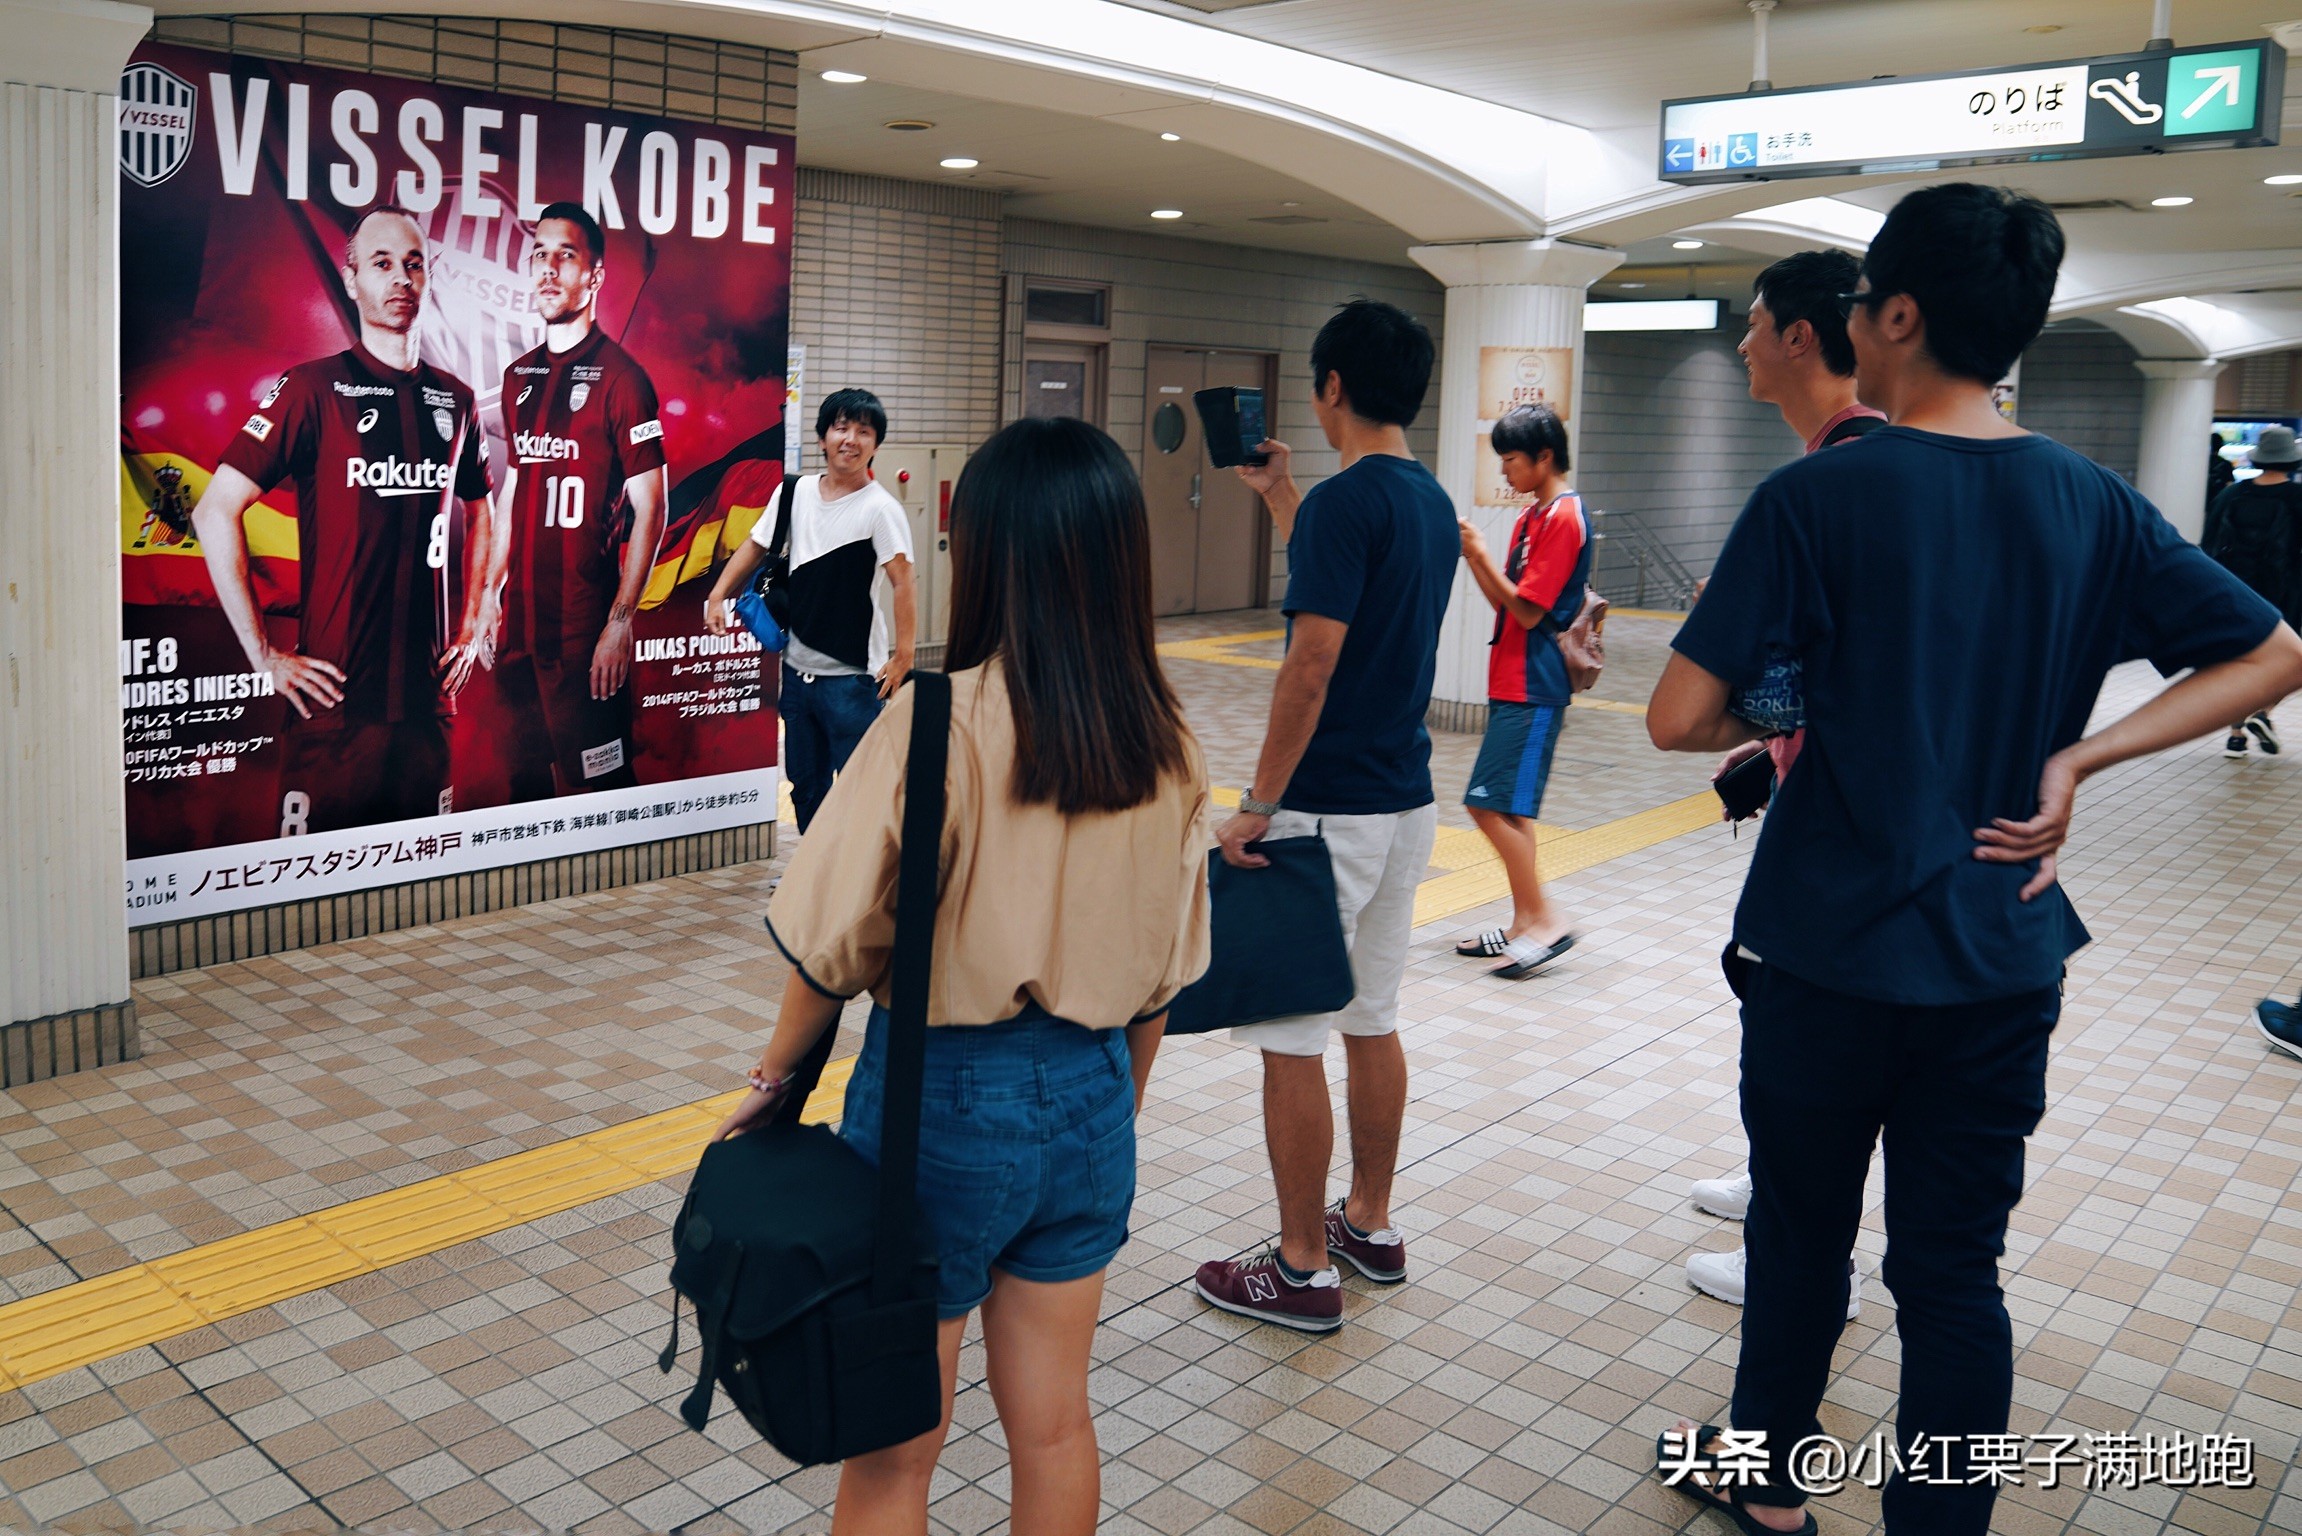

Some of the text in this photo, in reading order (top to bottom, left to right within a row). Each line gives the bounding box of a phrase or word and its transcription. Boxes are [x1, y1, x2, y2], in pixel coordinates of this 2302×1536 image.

[1969, 82, 2067, 115] のりば
[131, 110, 186, 129] VISSEL
[1993, 120, 2063, 135] Platform
[1766, 132, 1812, 149] お手洗
[209, 72, 778, 244] VISSEL KOBE
[443, 262, 540, 313] VISSEL
[1513, 387, 1544, 401] OPEN
[545, 476, 585, 529] 10
[426, 513, 449, 569] 8
[635, 636, 686, 662] LUKAS
[671, 661, 712, 676] ルーカス
[194, 671, 275, 702] INIESTA
[174, 705, 245, 725] イニエスタ
[678, 700, 738, 718] ブラジル大会
[206, 757, 237, 774] 優勝
[281, 790, 311, 837] 8
[189, 788, 759, 897] ノエビアスタジアム神戸 神戸市営地下鉄 海岸線「御崎公園駅」から徒歩約5分
